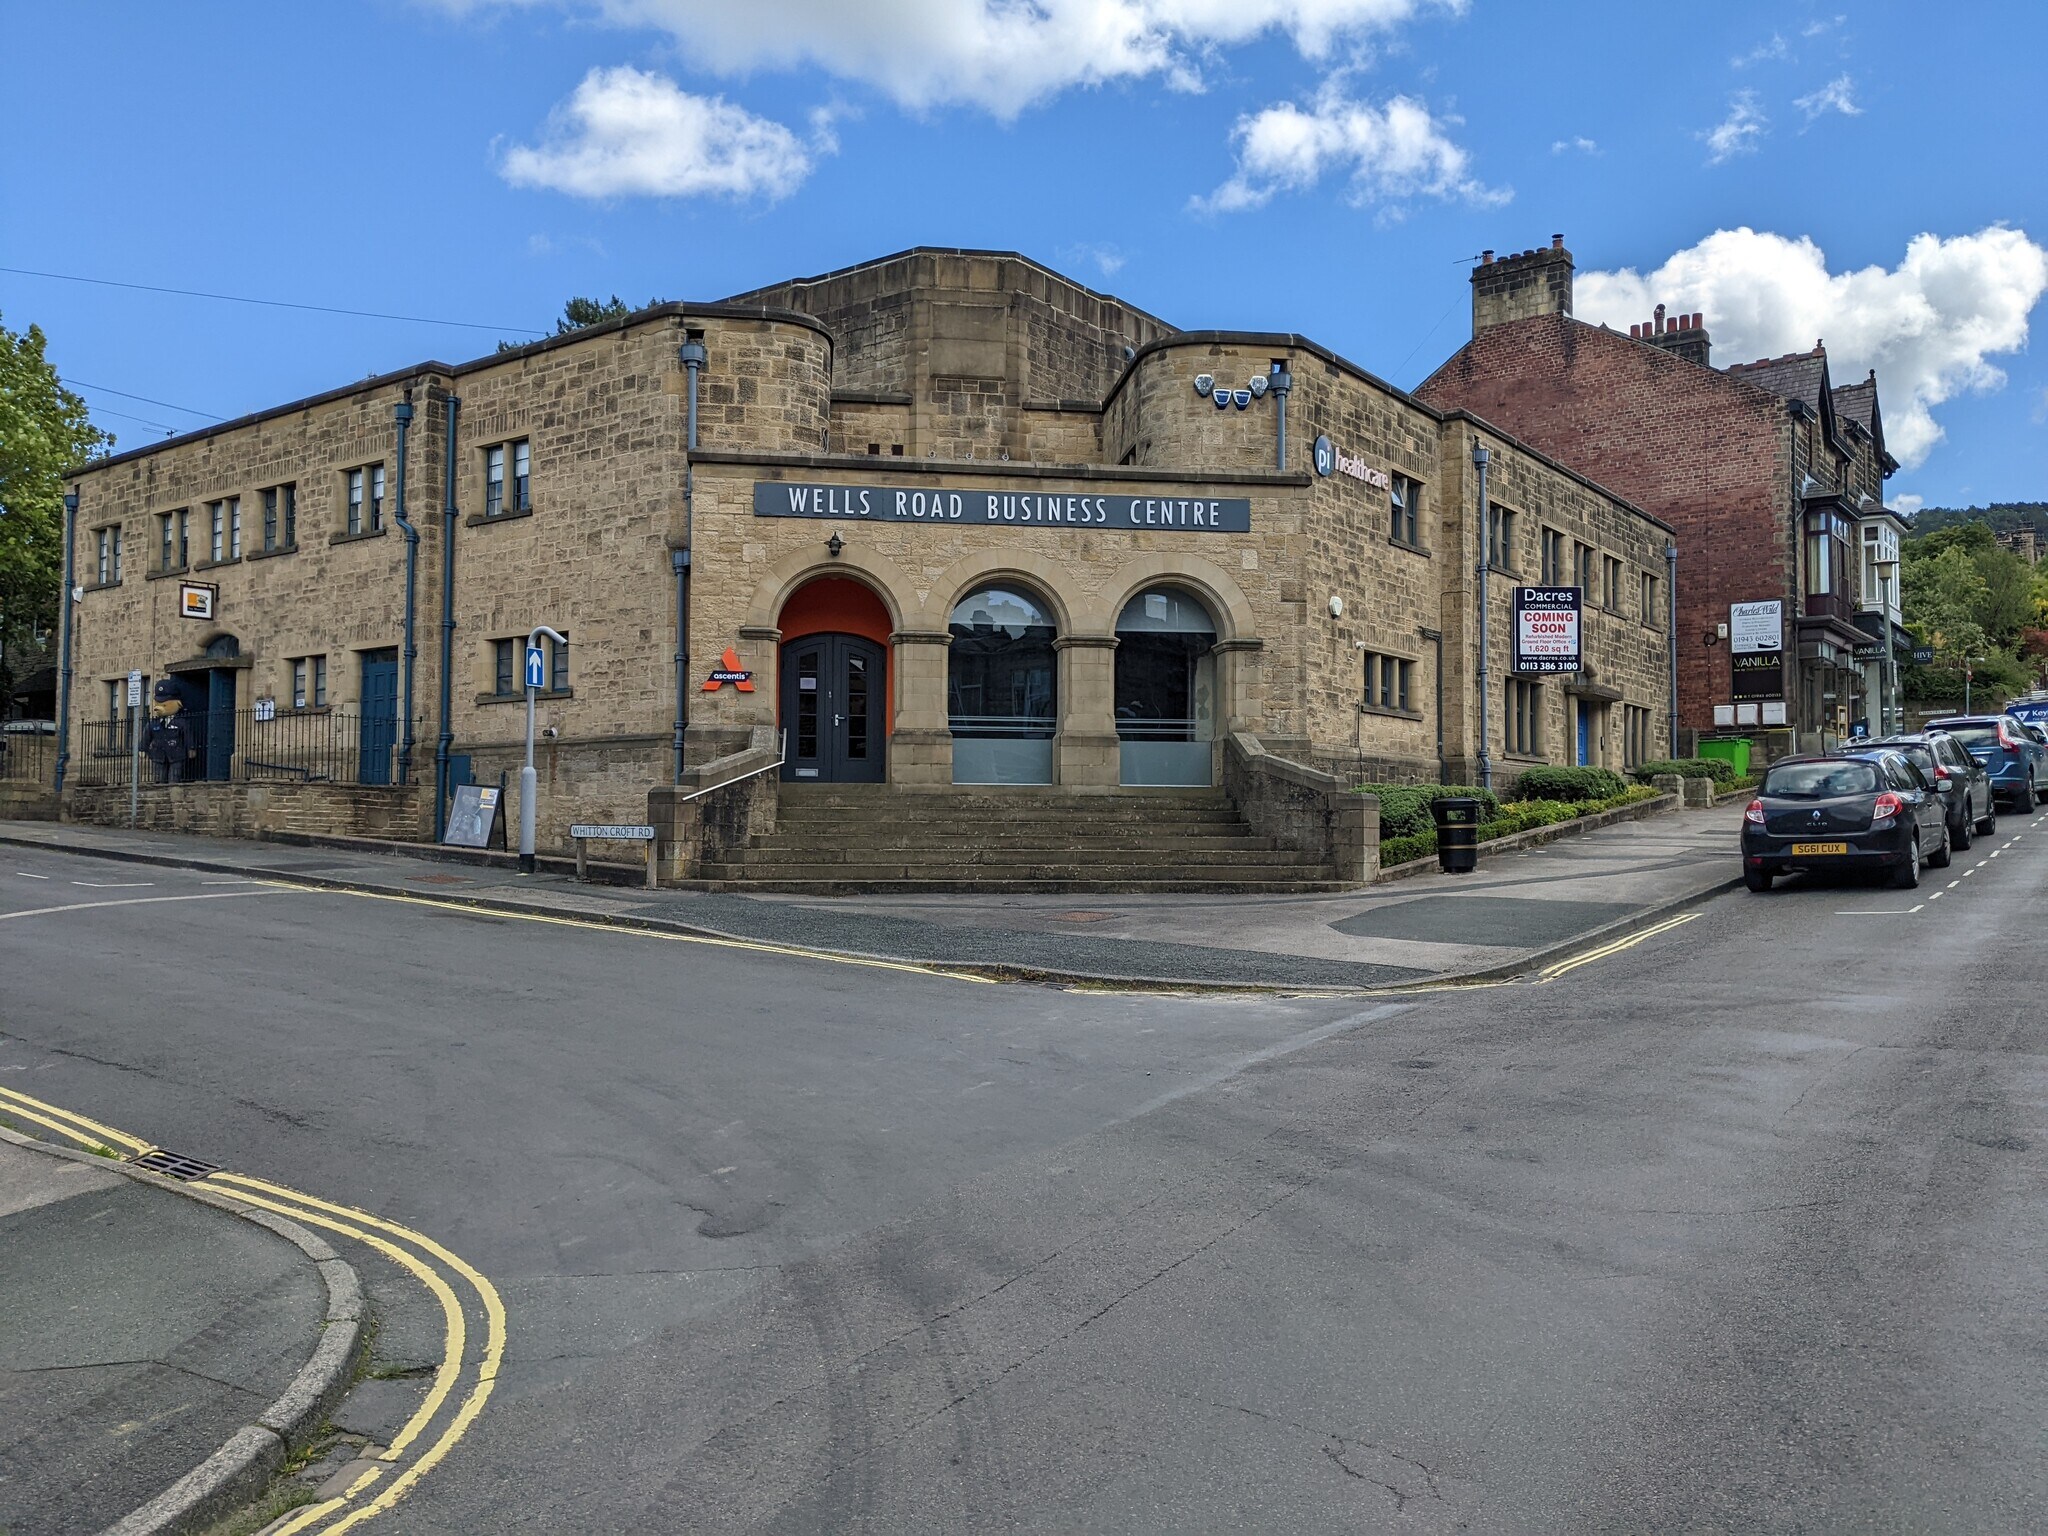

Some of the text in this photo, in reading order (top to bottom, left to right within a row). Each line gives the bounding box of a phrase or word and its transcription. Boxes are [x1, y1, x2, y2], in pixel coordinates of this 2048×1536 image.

[1318, 446, 1389, 490] pi healthcare
[788, 487, 1220, 526] WELLS ROAD BUSINESS CENTRE
[1524, 589, 1573, 602] Dacres
[1524, 612, 1574, 622] COMING
[1531, 623, 1566, 633] SOON
[1853, 646, 1887, 655] VANILLA
[1913, 651, 1933, 659] HIVE
[1520, 662, 1578, 670] 0113 386 3100
[1734, 656, 1780, 667] VANILLA
[713, 672, 746, 680] ascentis
[1856, 726, 1864, 737] P
[572, 826, 608, 837] WHITTON
[609, 827, 636, 837] CROFT
[1797, 844, 1840, 853] SG61 CUX
